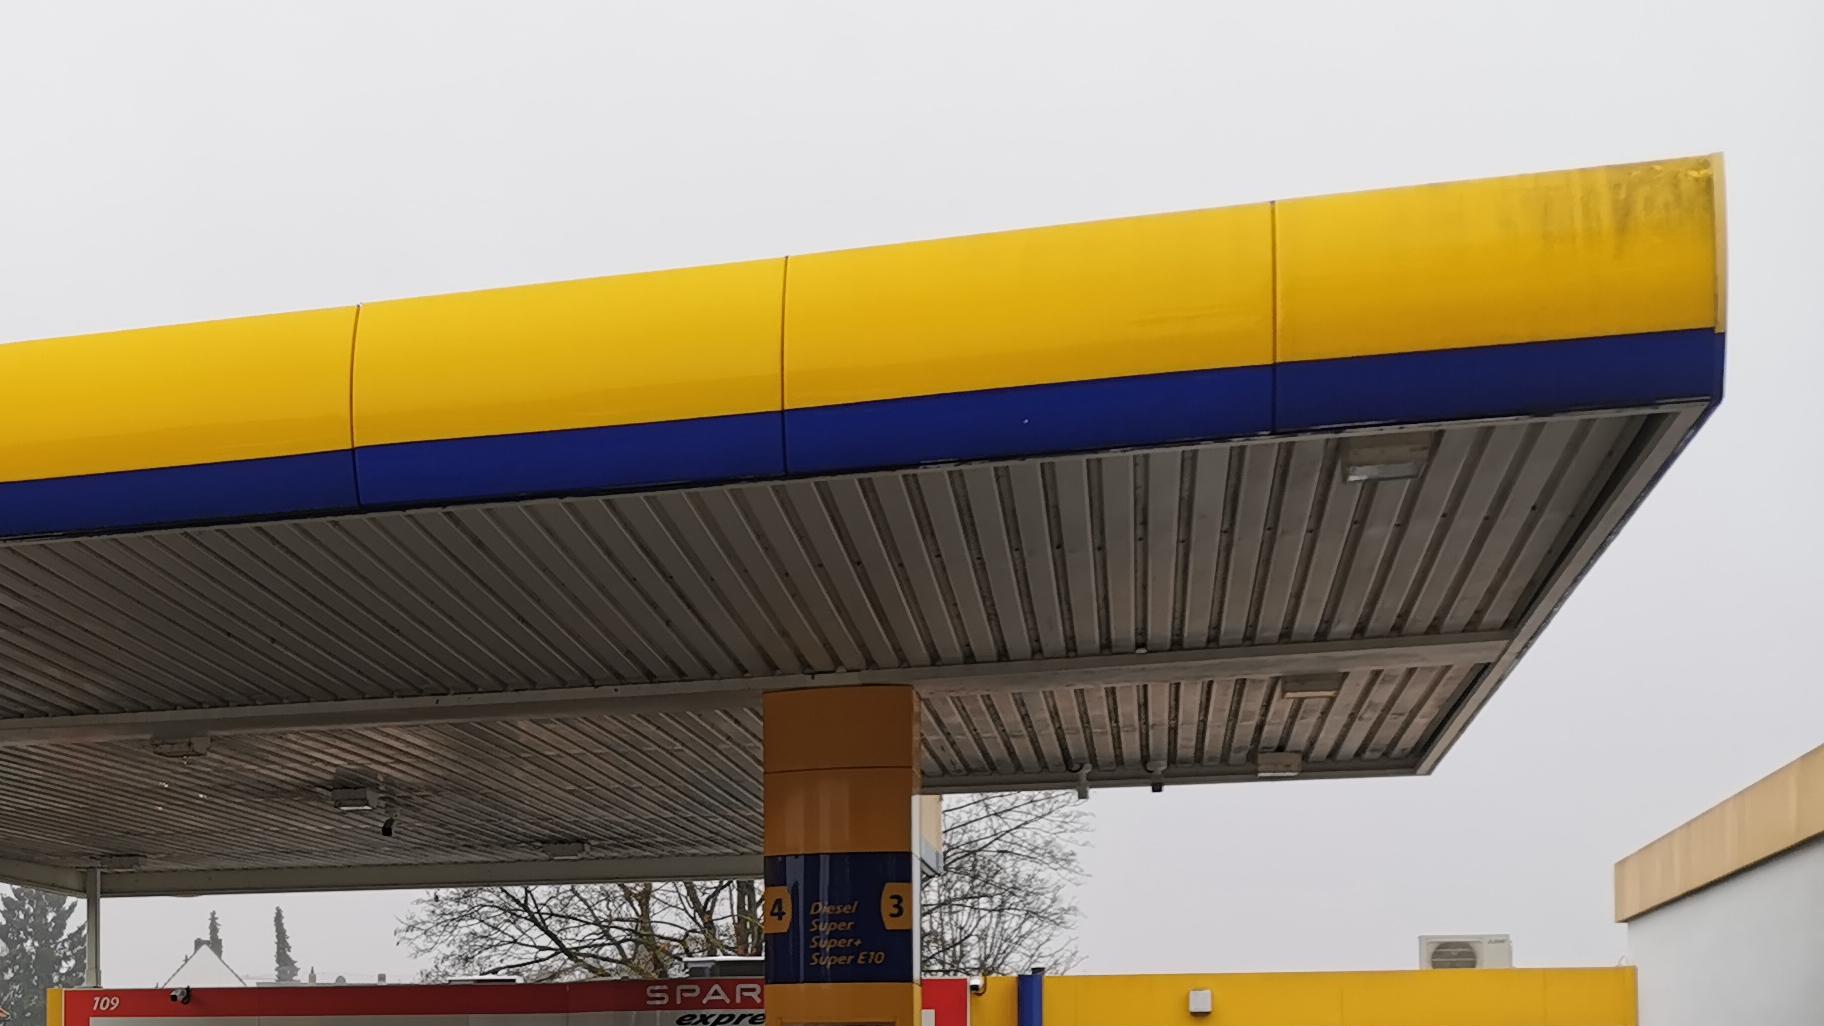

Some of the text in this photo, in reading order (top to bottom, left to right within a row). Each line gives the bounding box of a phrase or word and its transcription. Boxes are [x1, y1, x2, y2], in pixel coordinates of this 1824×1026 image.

[770, 899, 786, 921] 4
[810, 902, 858, 915] Diesel
[889, 895, 905, 918] 3
[810, 919, 855, 933] Super
[809, 936, 862, 950] Super+
[809, 952, 885, 968] Super E10
[646, 983, 762, 1005] SPAR
[93, 996, 120, 1011] 109
